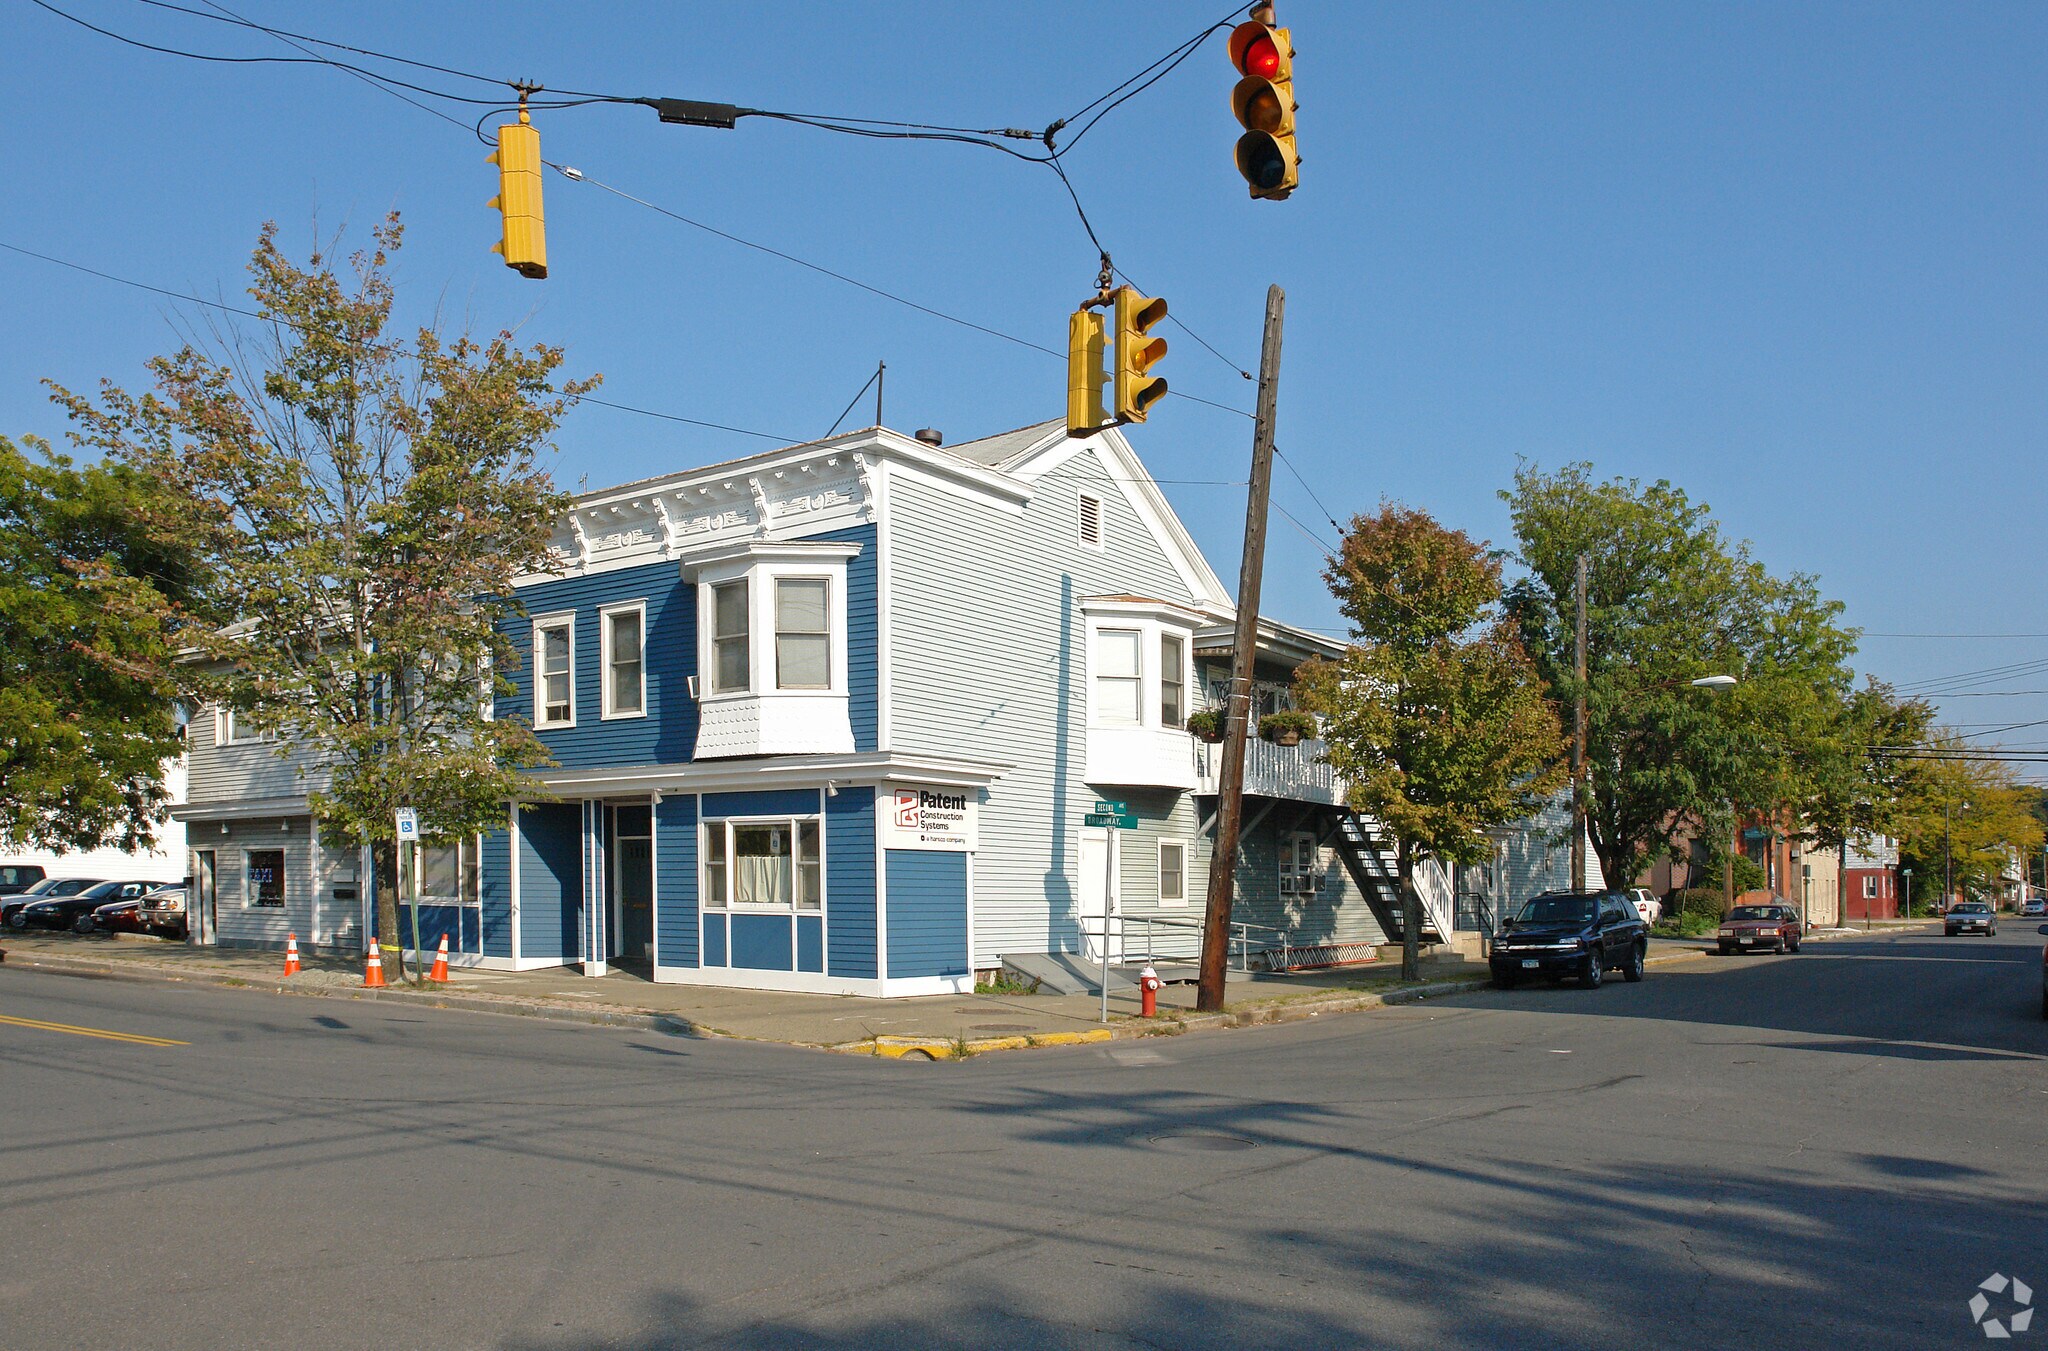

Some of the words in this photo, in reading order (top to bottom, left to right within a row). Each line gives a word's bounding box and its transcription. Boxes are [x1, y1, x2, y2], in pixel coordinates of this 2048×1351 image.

[920, 790, 966, 810] Patent
[1097, 803, 1114, 811] SECOND
[920, 810, 963, 820] Construction
[920, 820, 949, 831] Systems
[249, 868, 273, 883] TAXI
